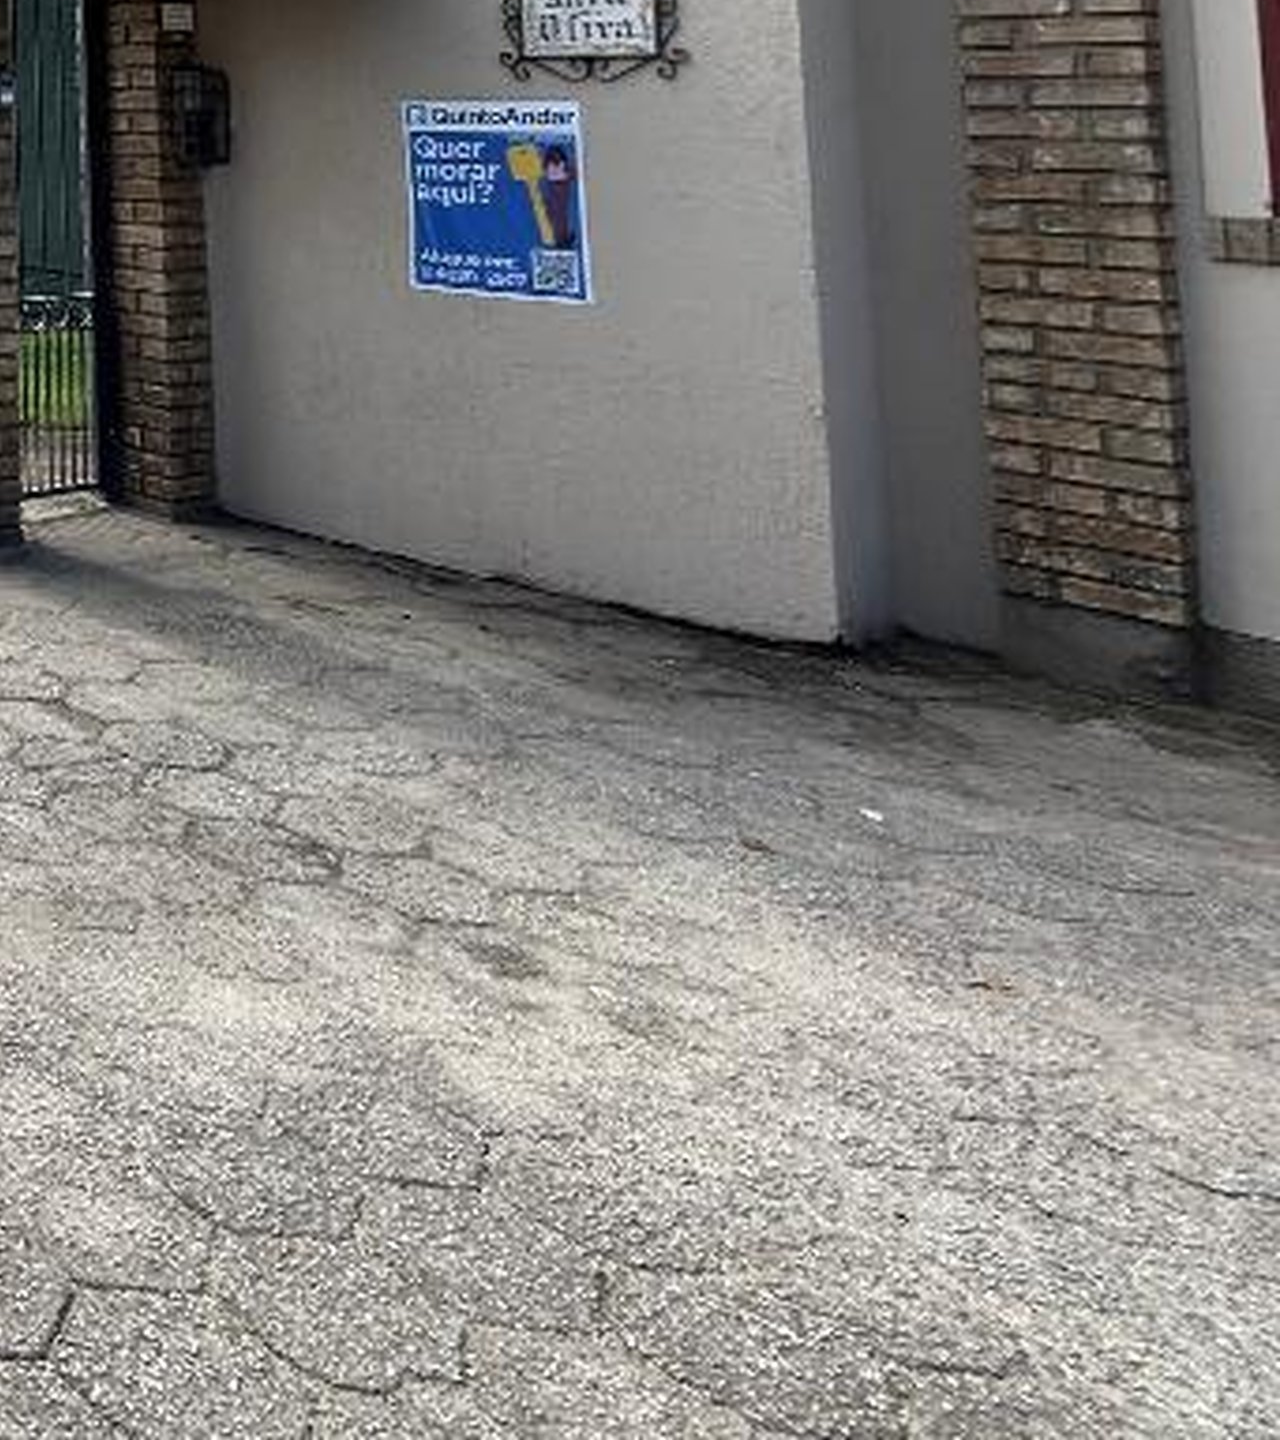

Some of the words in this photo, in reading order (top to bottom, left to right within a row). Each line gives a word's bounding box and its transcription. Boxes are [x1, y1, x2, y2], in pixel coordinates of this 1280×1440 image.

[432, 107, 576, 126] QuintoAndar
[415, 137, 486, 159] Quer
[416, 162, 501, 181] morar
[417, 182, 494, 207] aqui?
